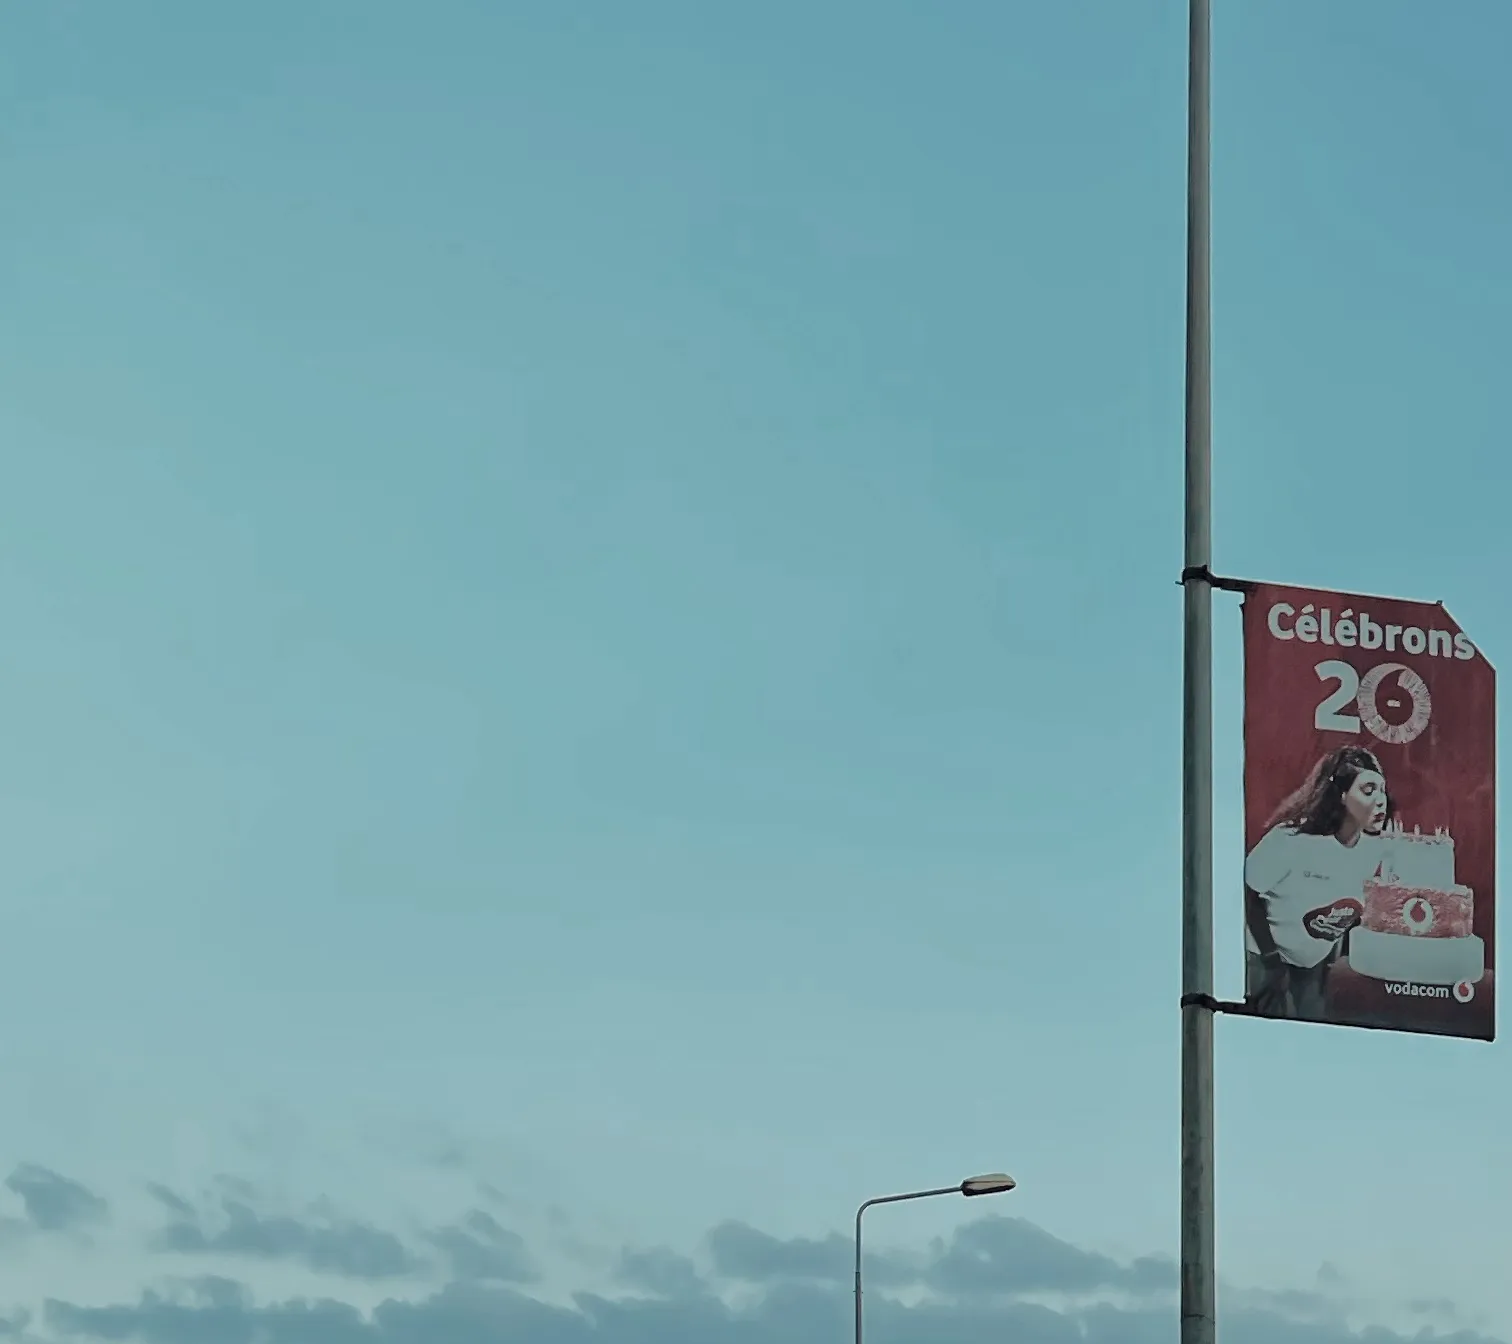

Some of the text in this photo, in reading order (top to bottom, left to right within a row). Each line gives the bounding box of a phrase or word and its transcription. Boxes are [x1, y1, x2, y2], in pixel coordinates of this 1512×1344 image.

[1267, 602, 1475, 660] Célébrons
[1314, 660, 1432, 744] 20
[1385, 977, 1449, 998] vodacom
